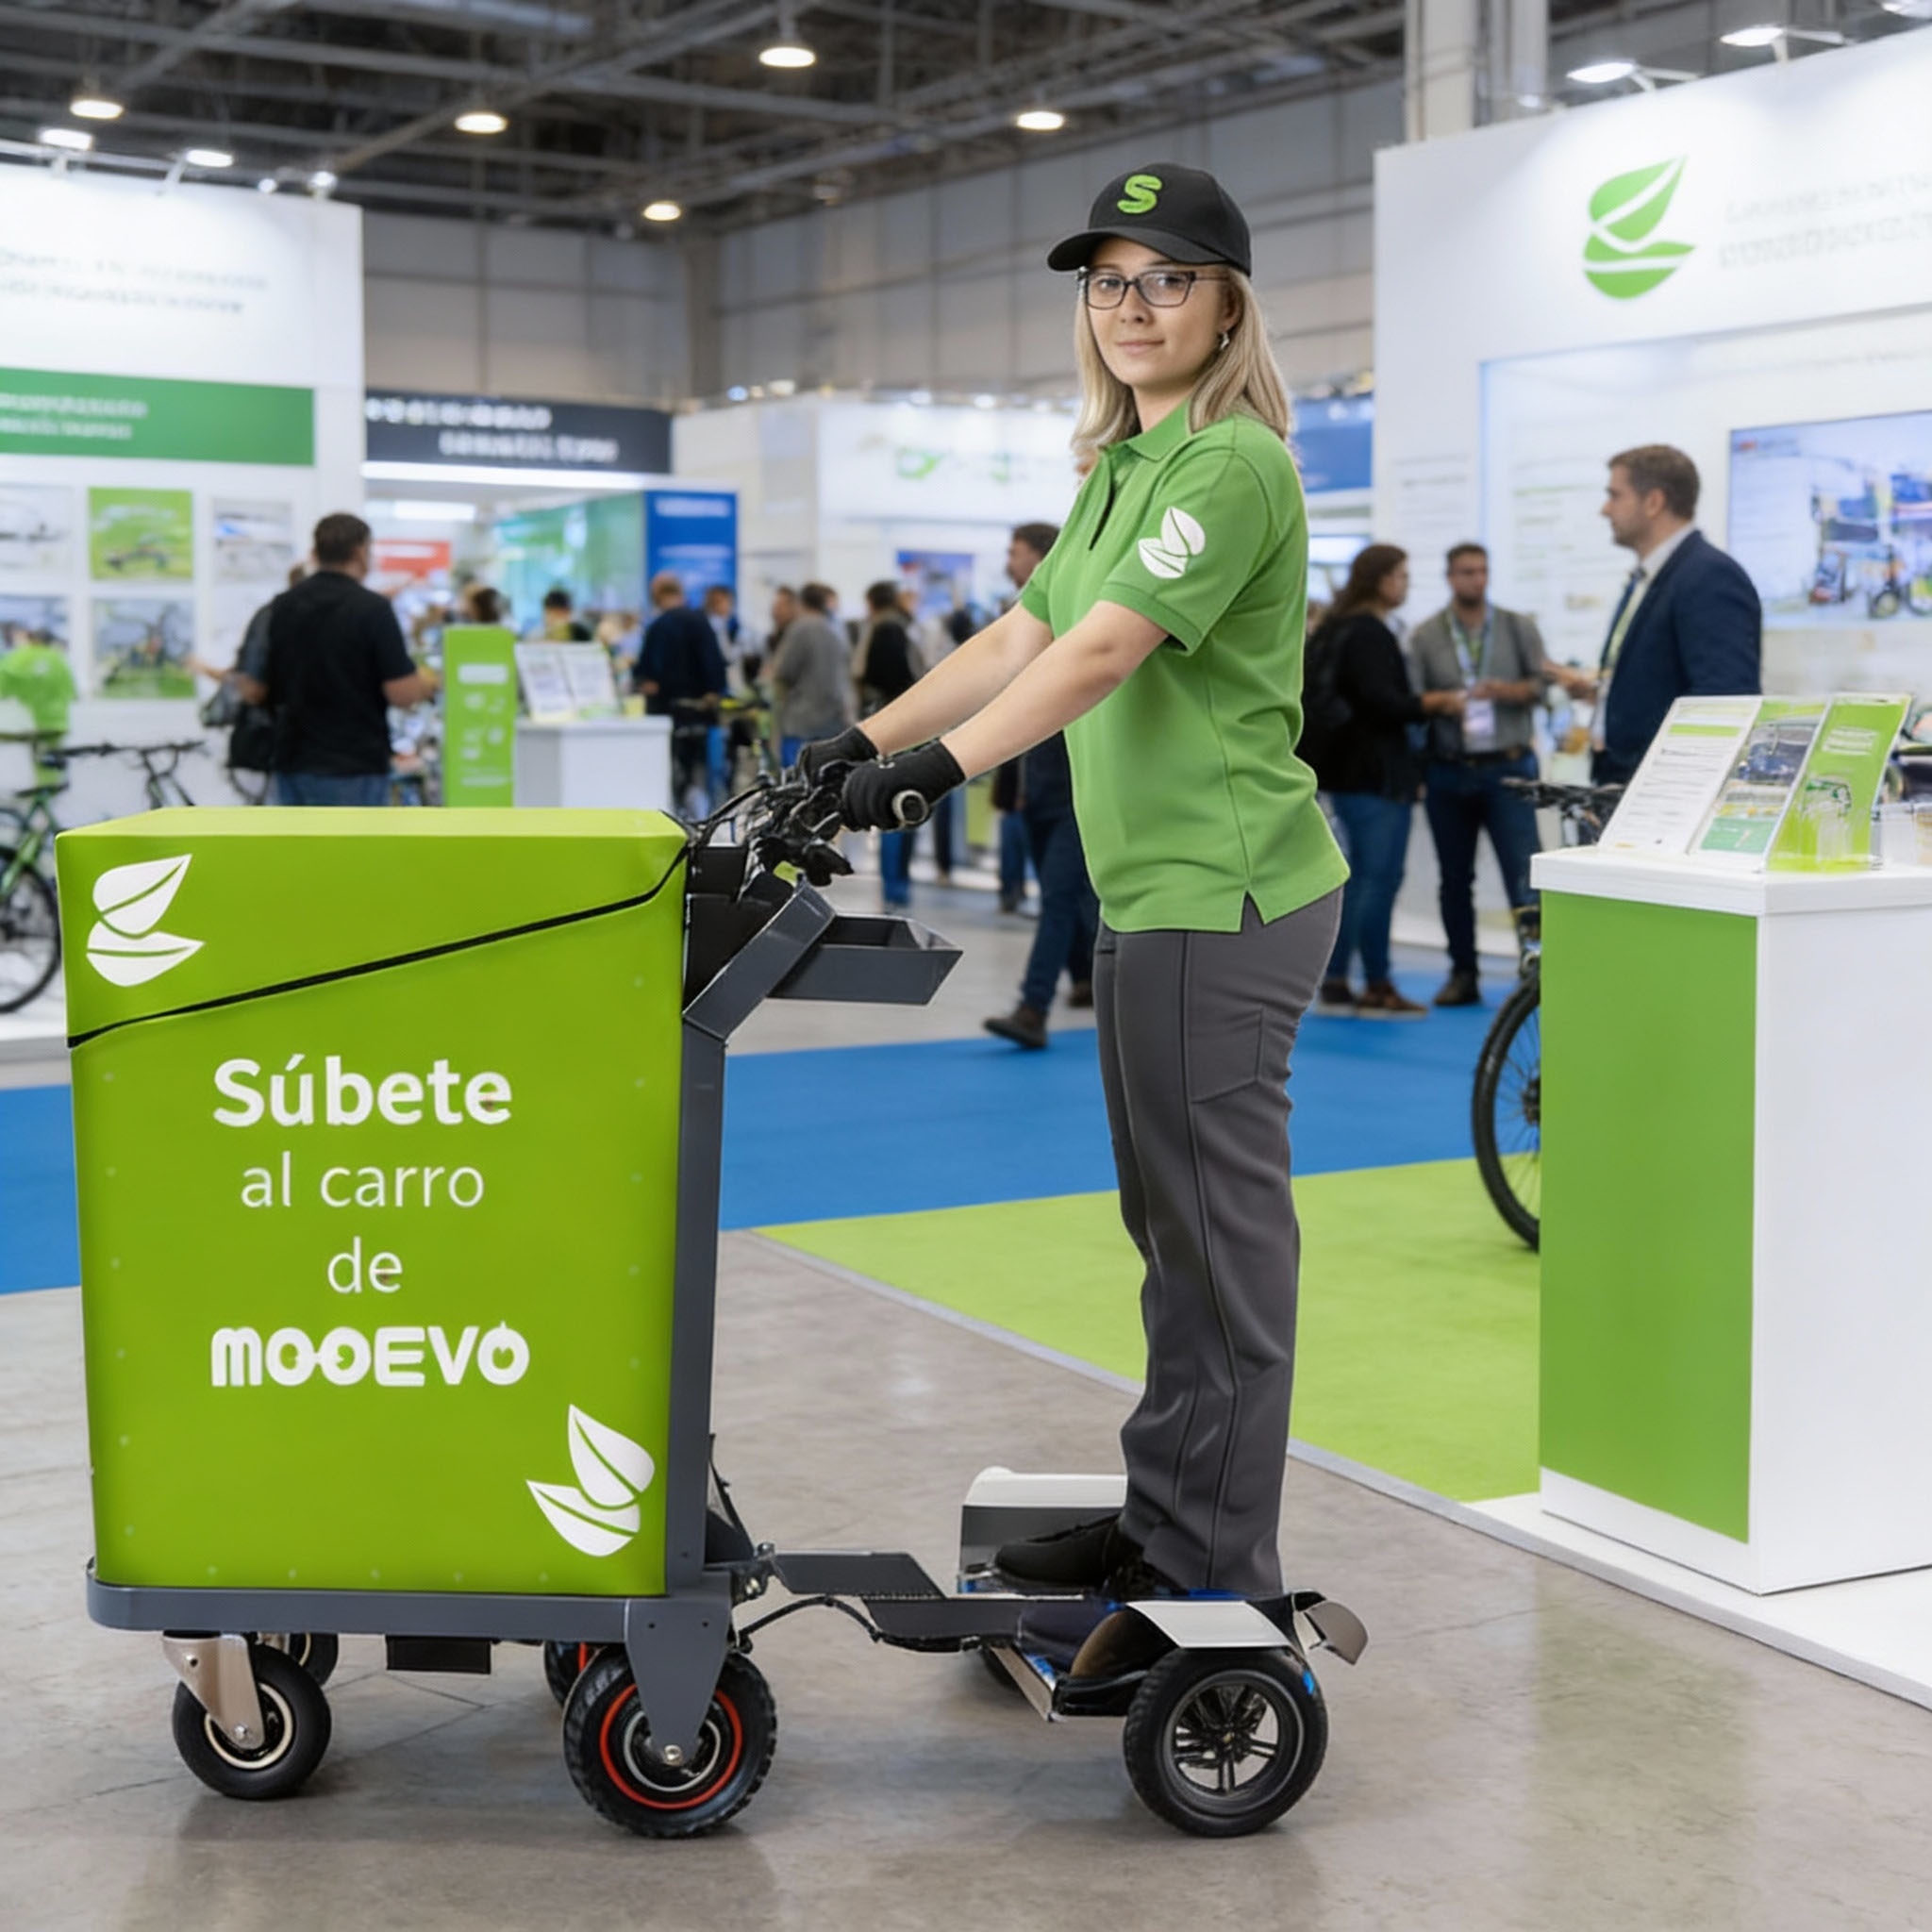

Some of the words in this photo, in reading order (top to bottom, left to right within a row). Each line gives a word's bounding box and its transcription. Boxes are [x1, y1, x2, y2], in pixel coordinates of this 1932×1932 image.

[1117, 174, 1162, 214] S
[213, 1053, 512, 1127] Súbete
[241, 1150, 291, 1208] al
[320, 1166, 484, 1208] carro
[326, 1236, 403, 1293] de
[210, 1320, 530, 1387] MOOEVO
